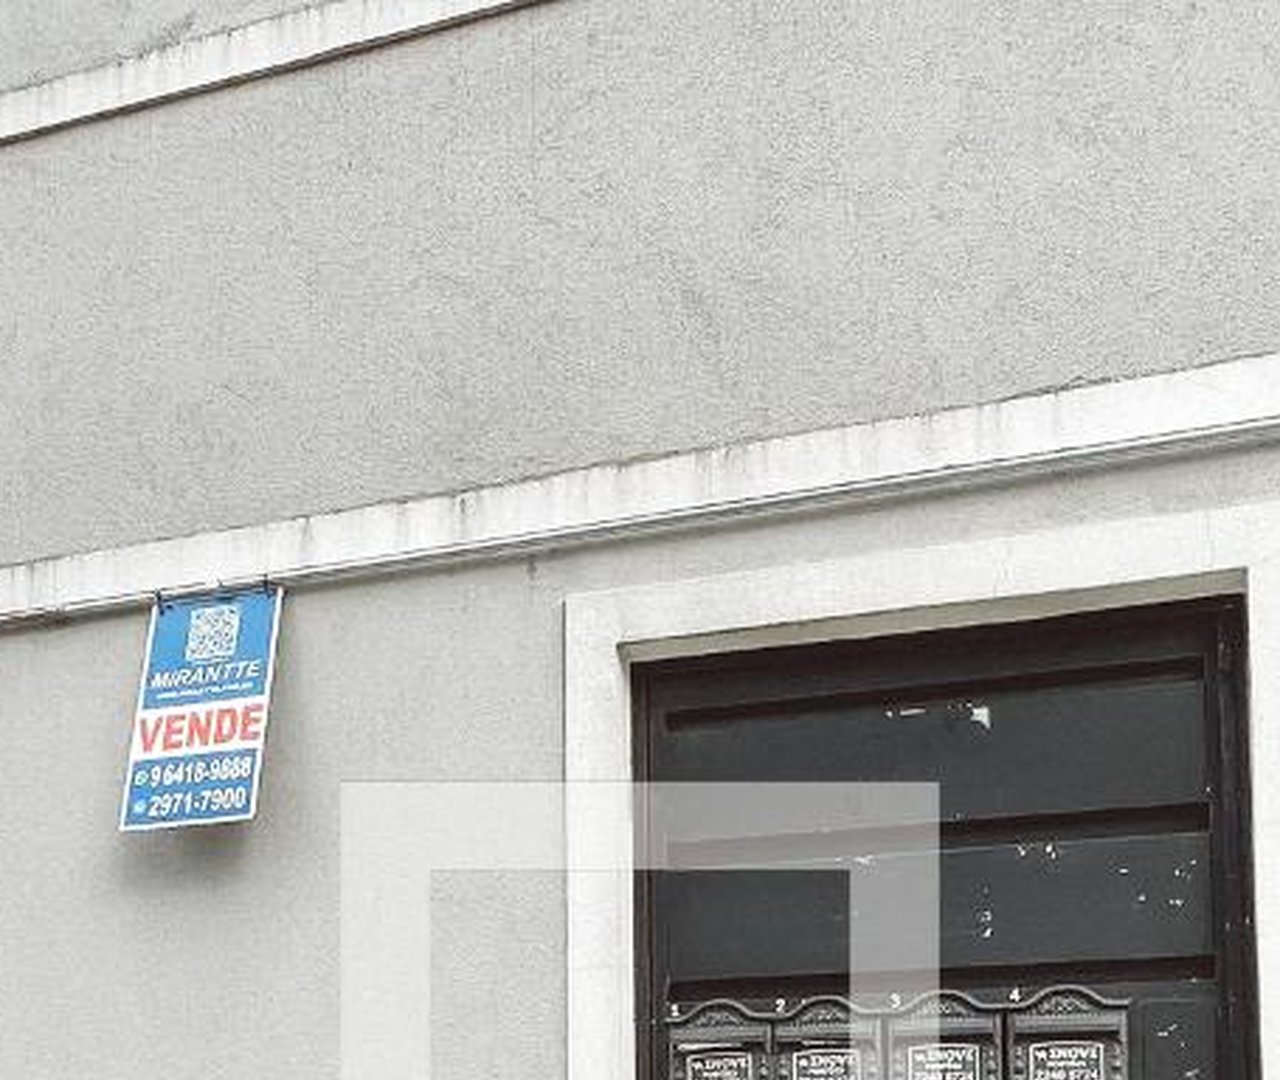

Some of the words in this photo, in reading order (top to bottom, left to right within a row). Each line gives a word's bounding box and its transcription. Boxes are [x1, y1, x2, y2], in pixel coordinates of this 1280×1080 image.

[138, 703, 264, 753] VENDE
[890, 993, 902, 1009] 3
[1009, 987, 1020, 1002] 4
[671, 1004, 680, 1017] 1
[775, 1000, 786, 1013] 2
